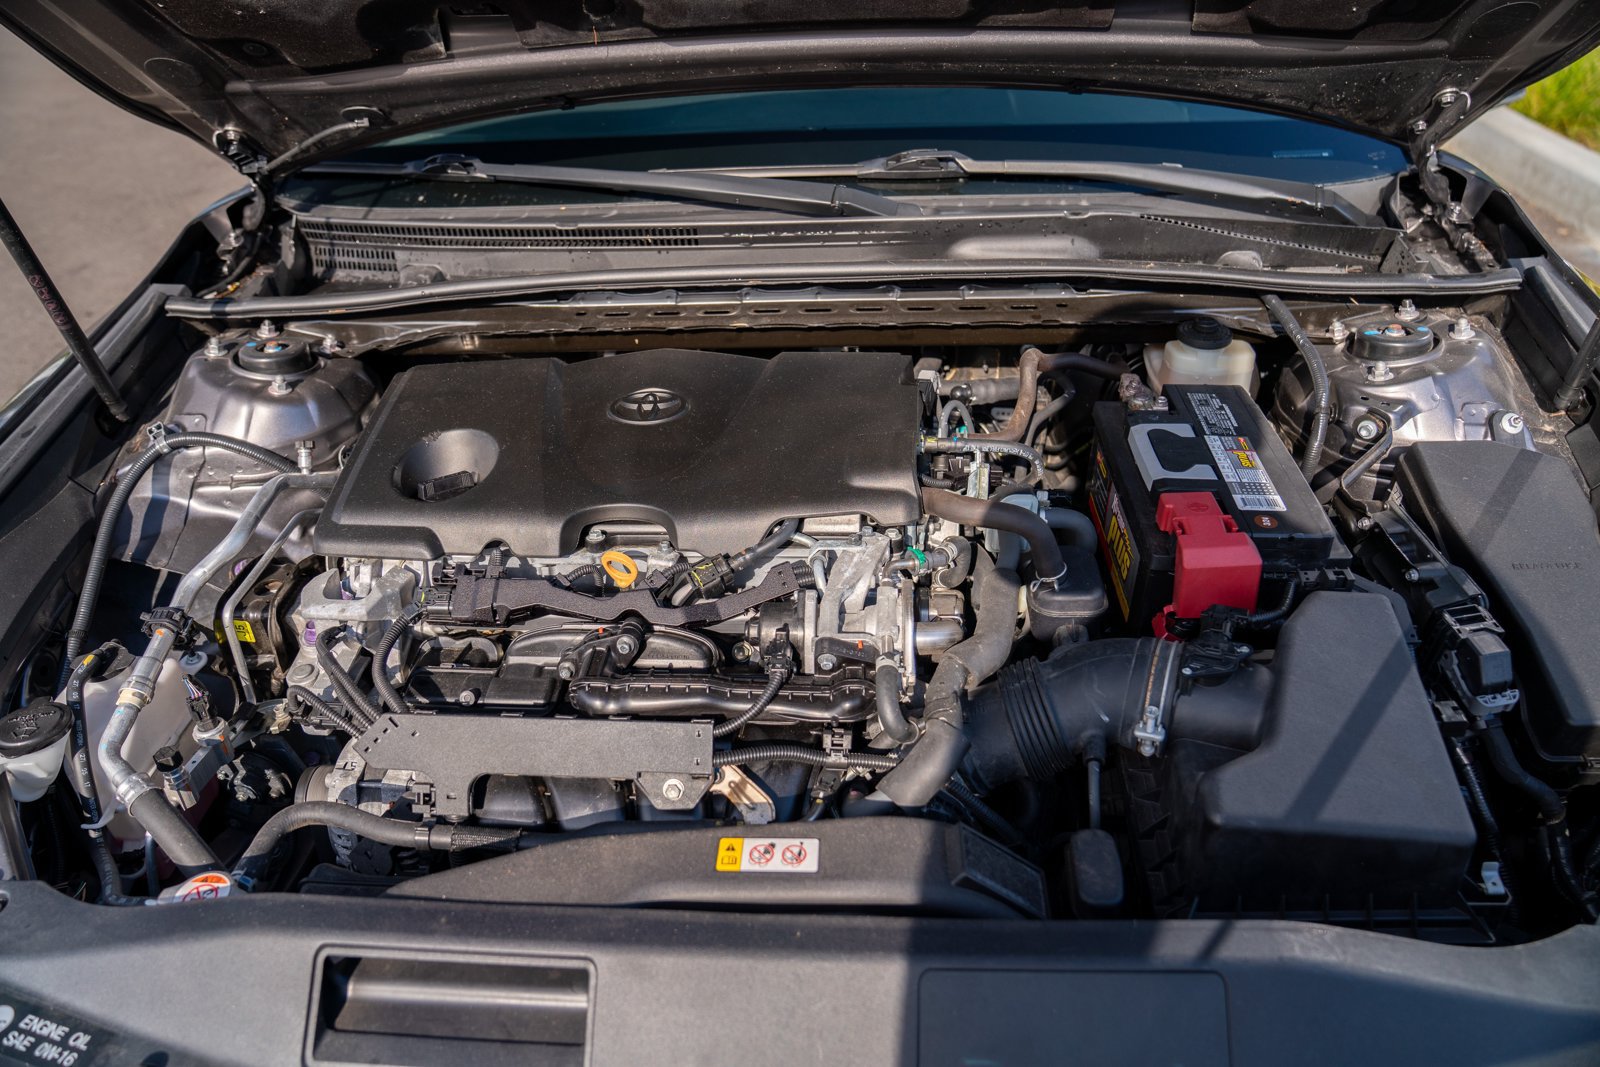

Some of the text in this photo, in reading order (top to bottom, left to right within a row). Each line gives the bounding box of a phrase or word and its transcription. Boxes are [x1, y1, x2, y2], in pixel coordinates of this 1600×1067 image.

[2, 1030, 36, 1052] SAE
[18, 1014, 92, 1051] ENGINE OIL
